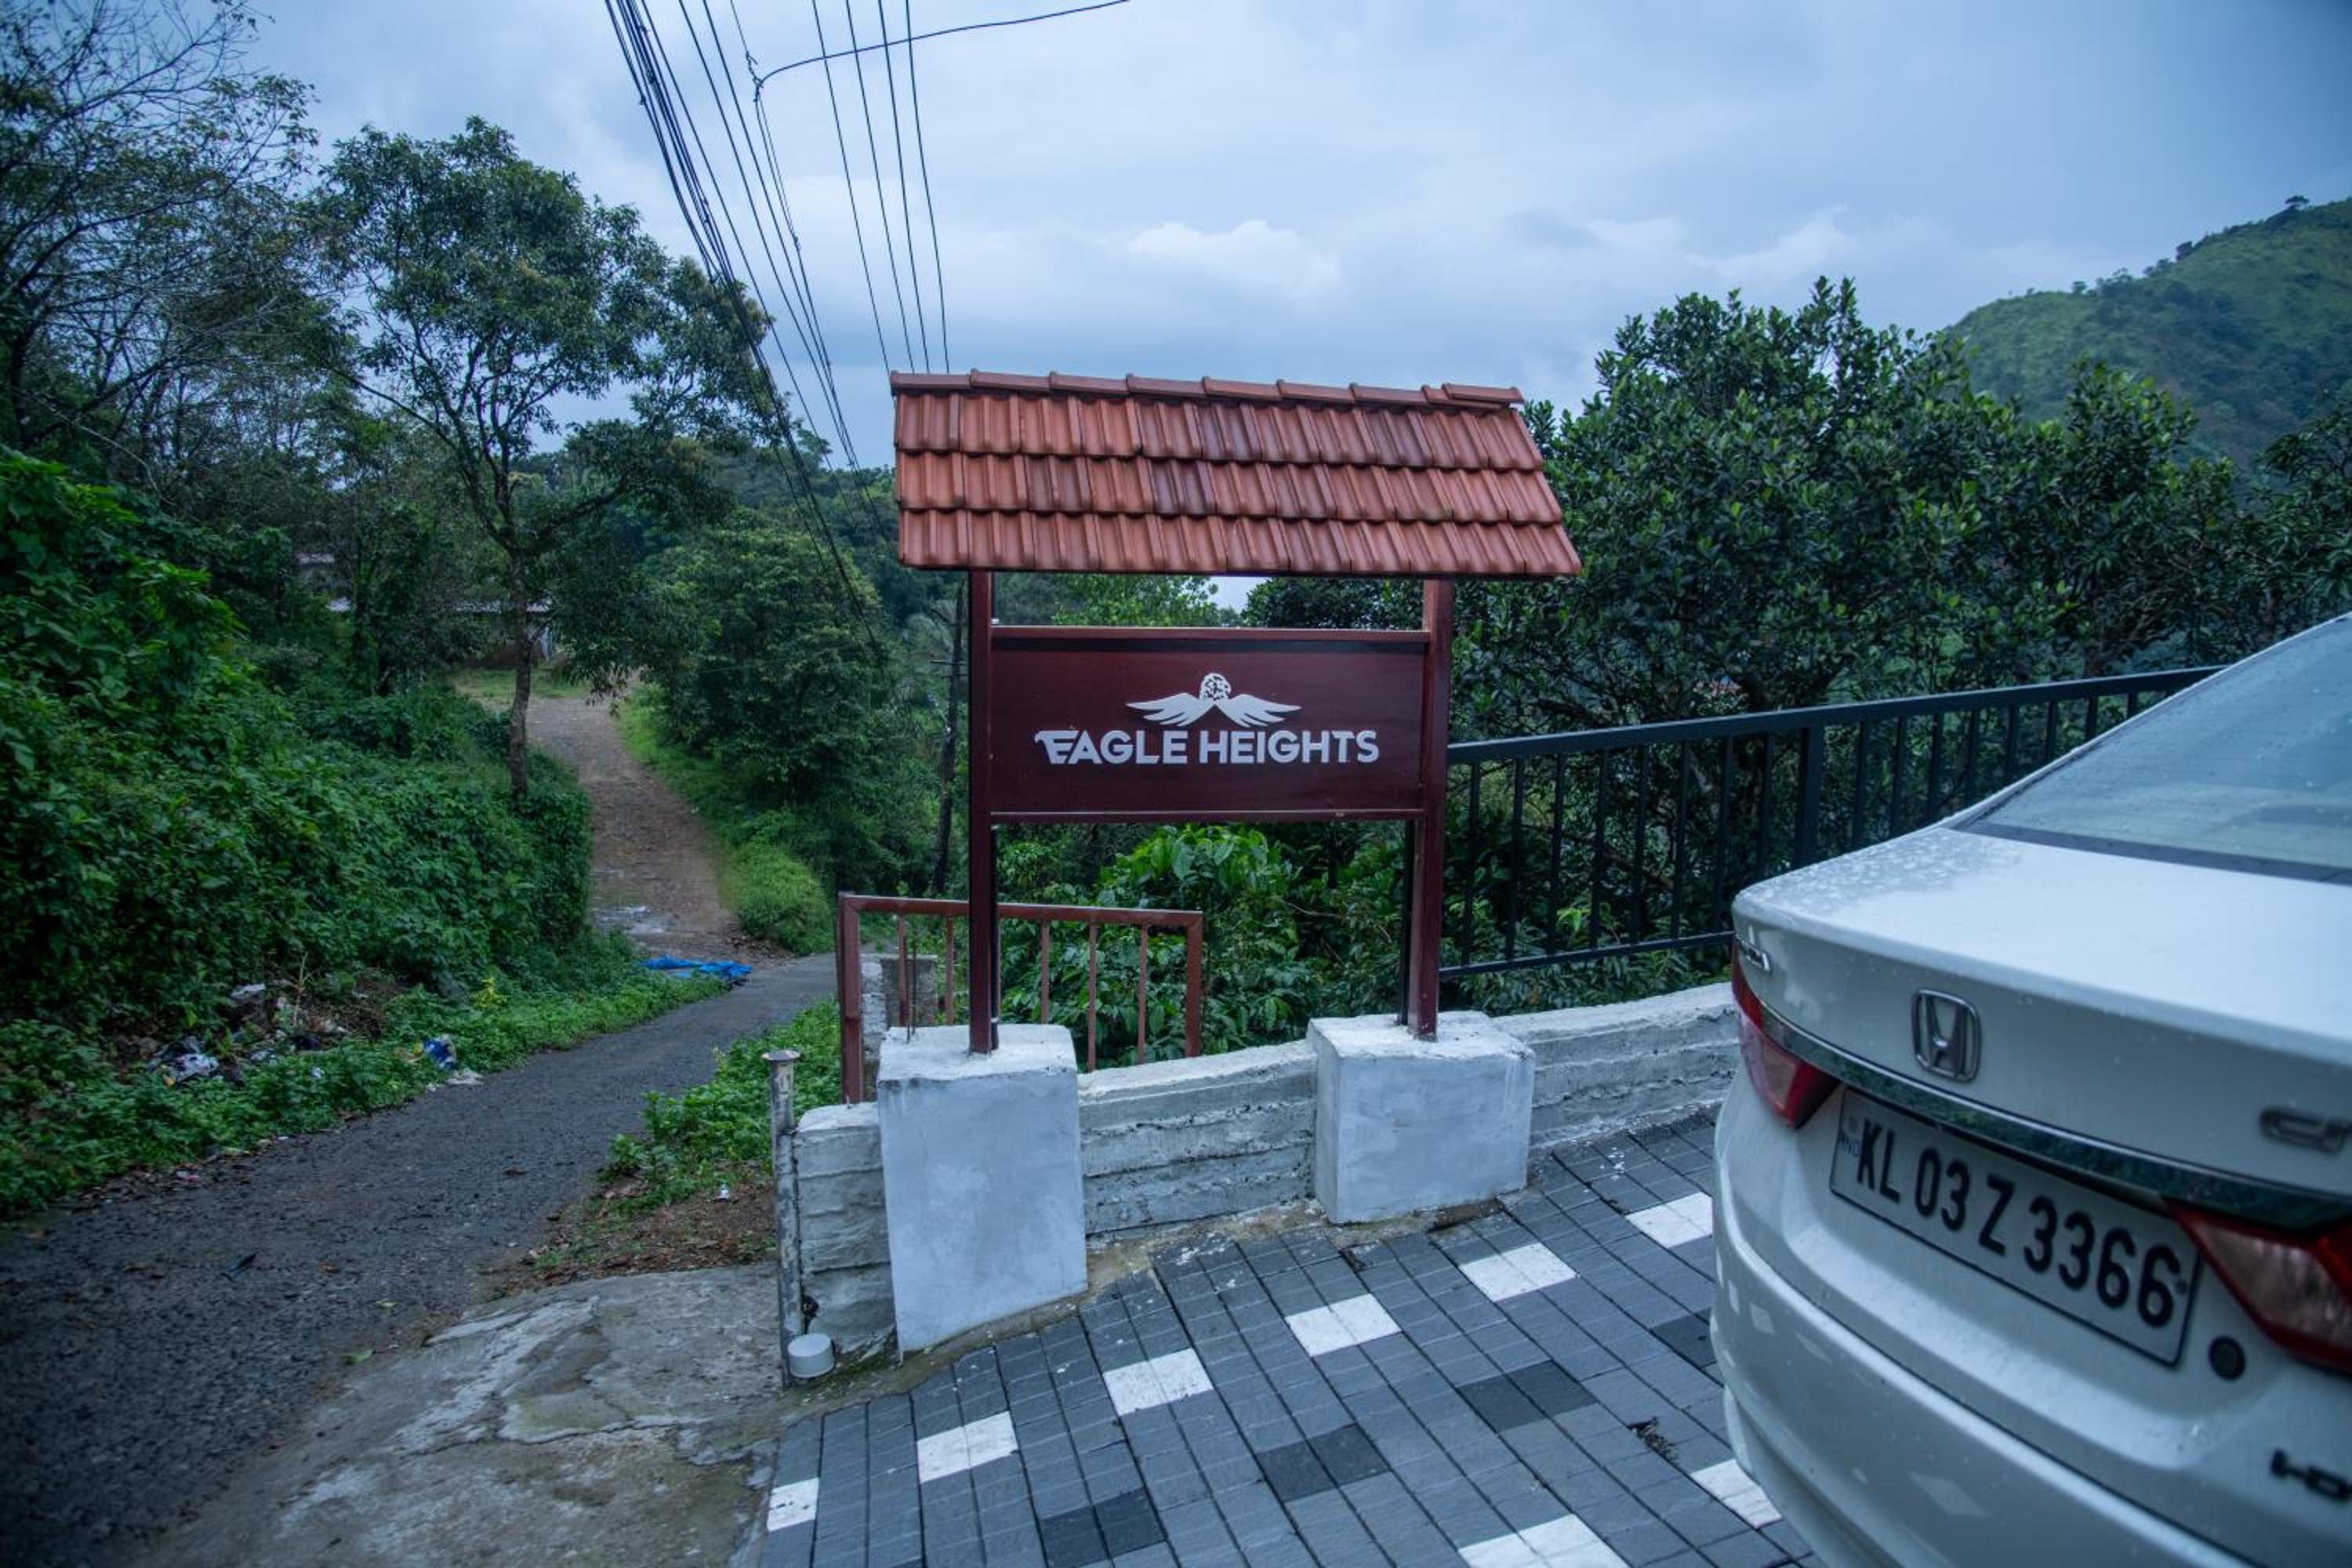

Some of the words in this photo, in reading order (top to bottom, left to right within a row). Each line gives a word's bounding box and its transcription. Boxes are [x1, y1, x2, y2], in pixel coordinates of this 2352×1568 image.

[1034, 730, 1189, 764] EAGLE
[1199, 730, 1380, 764] HEIGHTS
[1857, 1119, 1900, 1203] KL
[1915, 1147, 1970, 1232] 03
[1979, 1175, 2016, 1258] Z
[2023, 1196, 2180, 1329] 3366
